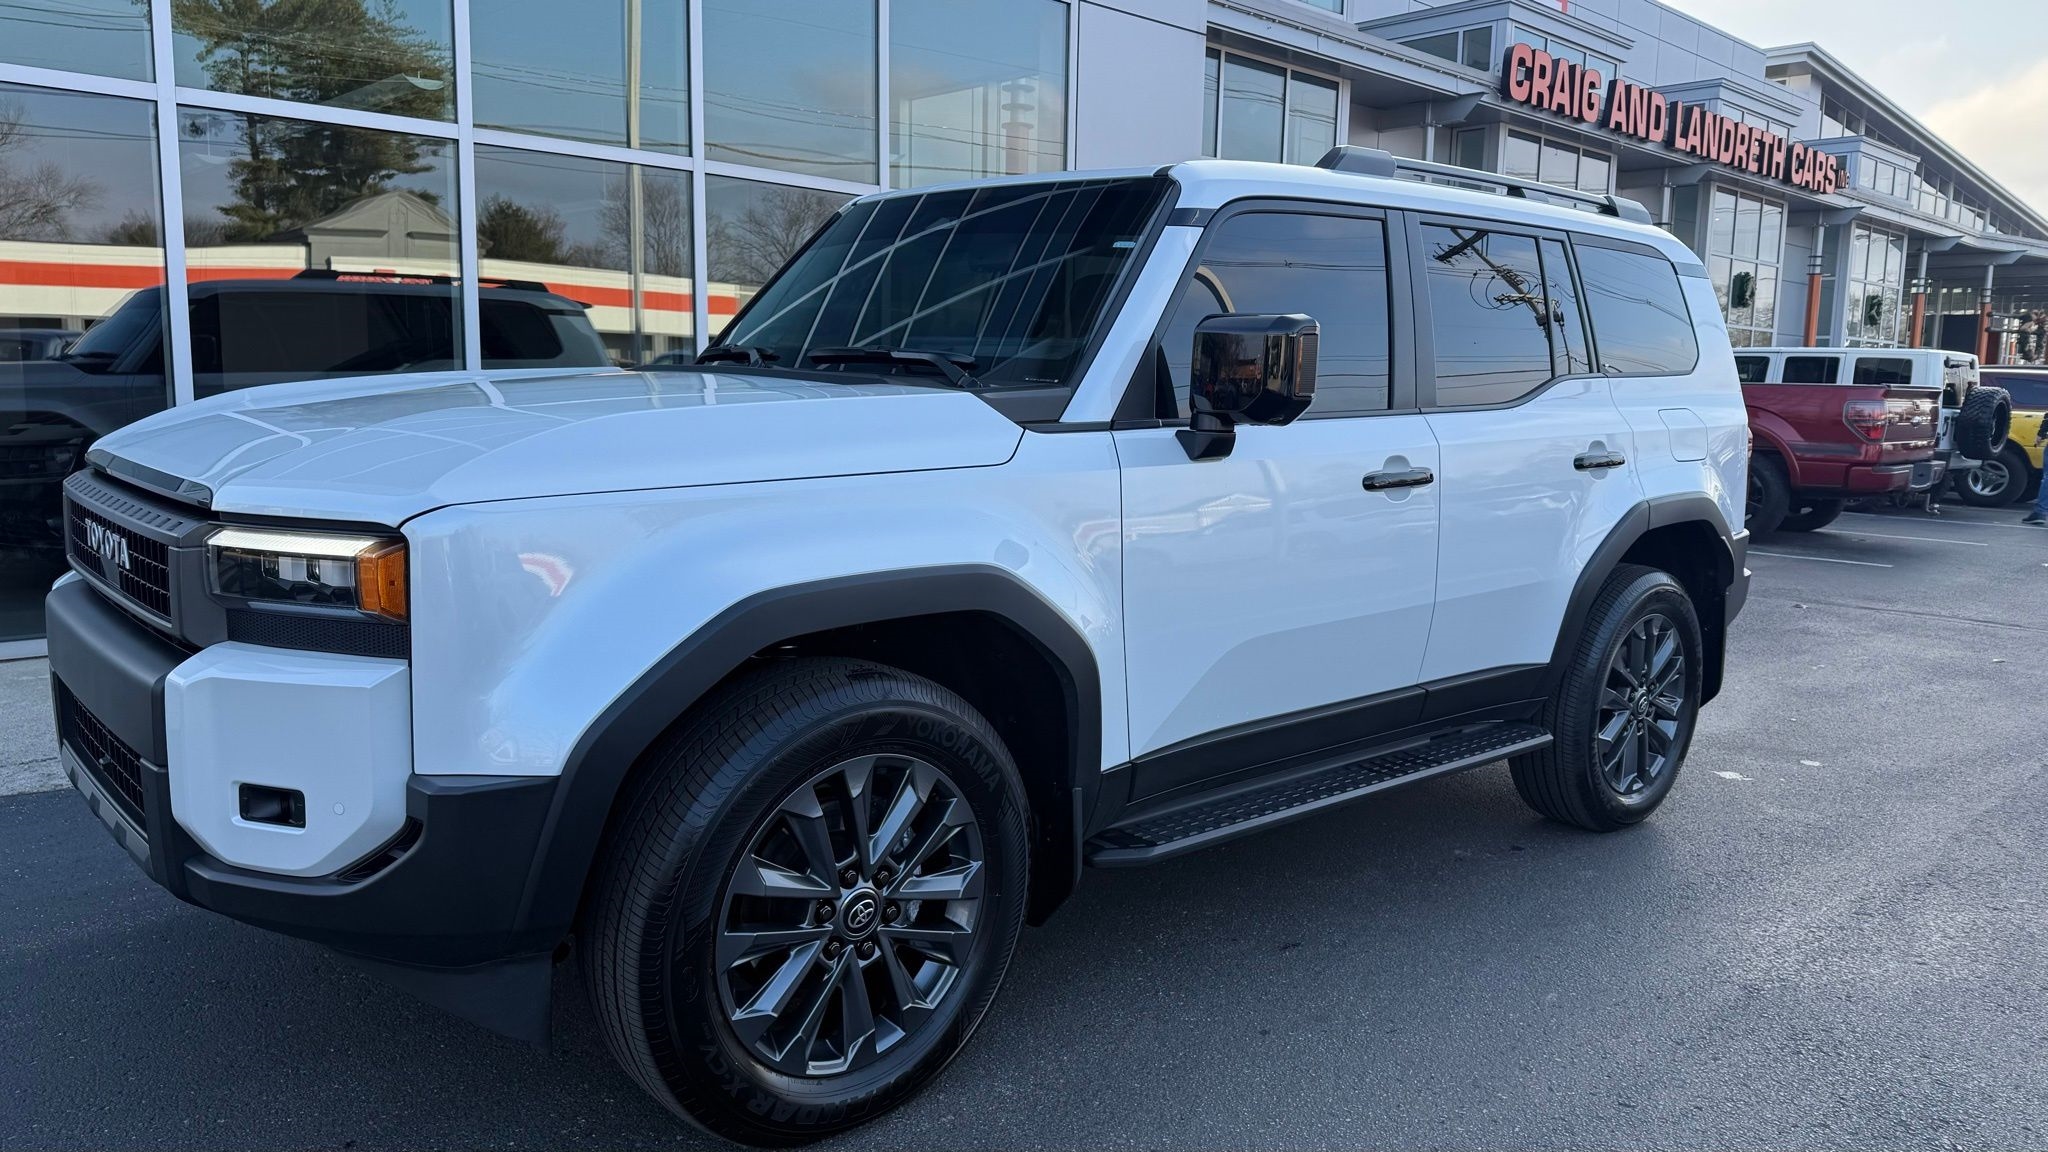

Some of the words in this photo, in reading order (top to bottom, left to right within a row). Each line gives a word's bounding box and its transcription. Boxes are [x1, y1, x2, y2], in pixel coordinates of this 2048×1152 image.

[1509, 43, 1601, 123] CRAIG
[1609, 79, 1666, 142] AND
[1675, 101, 1787, 179] LANDRETH
[1791, 143, 1837, 194] CARS
[85, 518, 131, 570] TOYOTA
[906, 715, 1001, 793] YOKOHAMA
